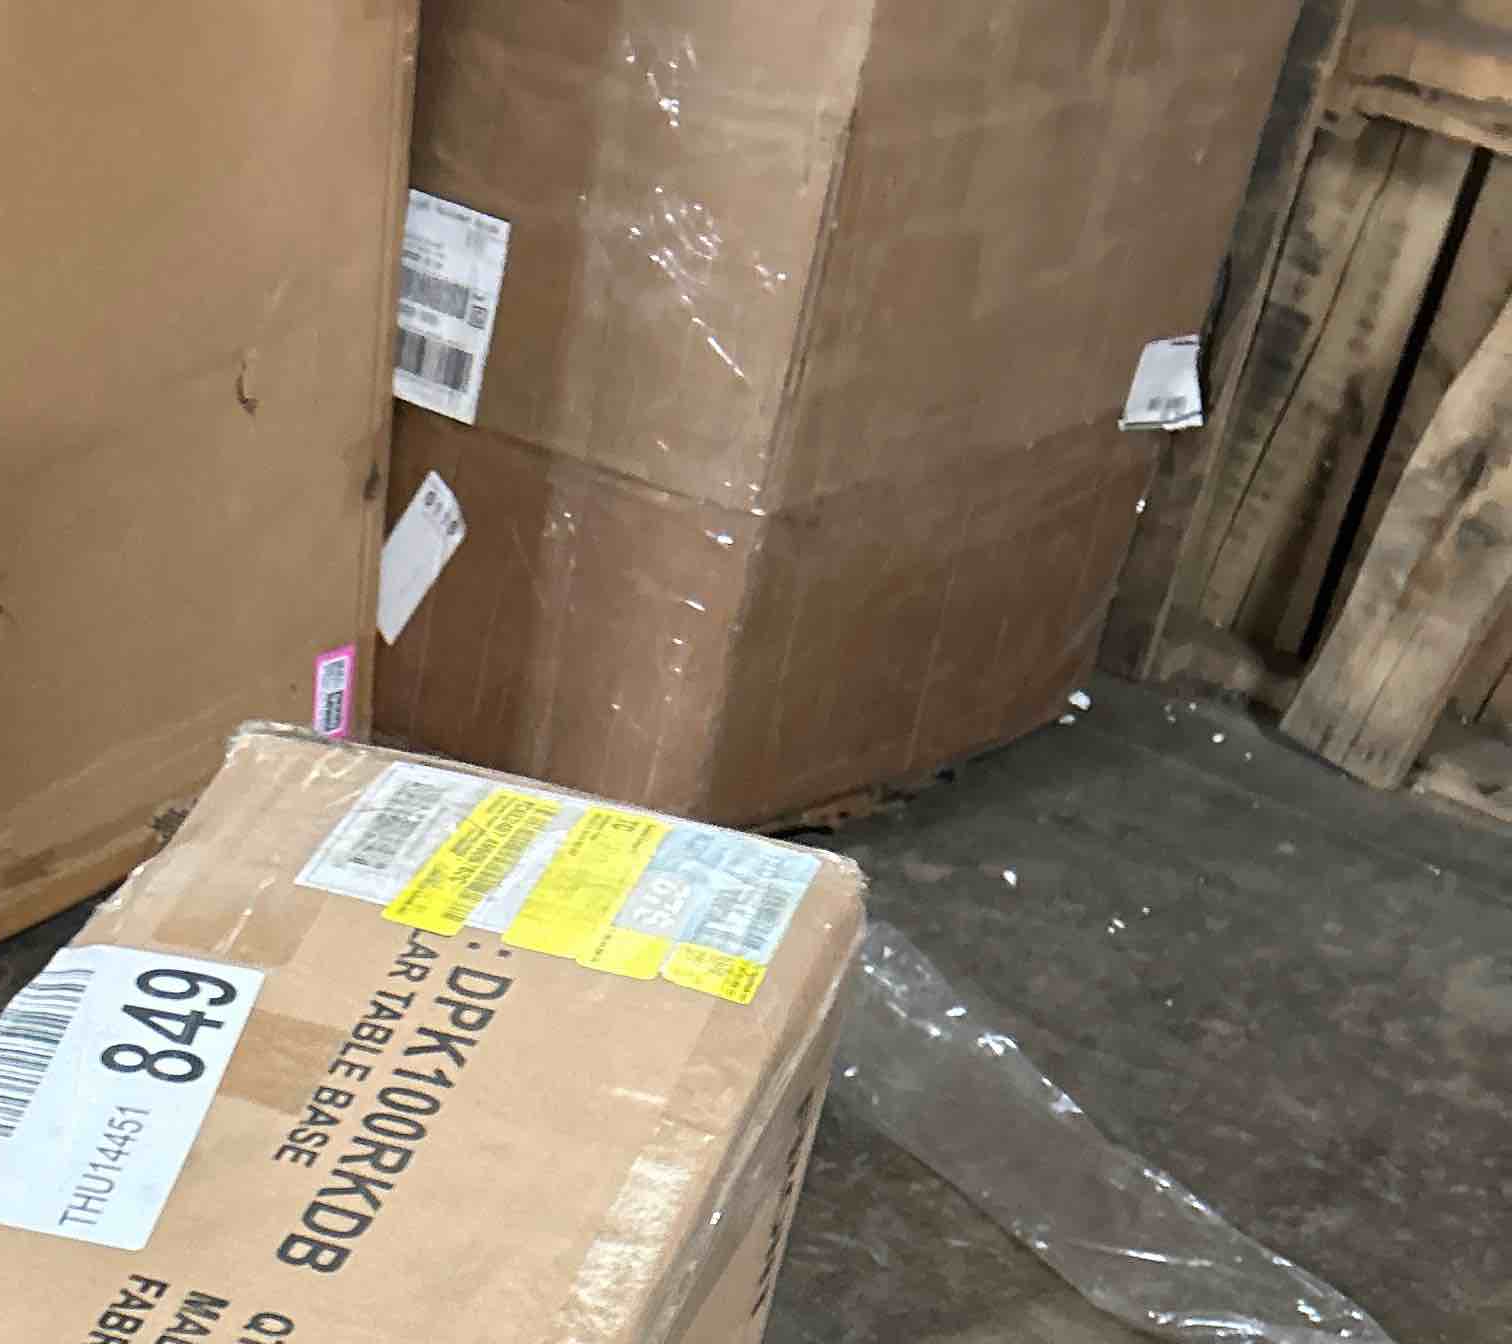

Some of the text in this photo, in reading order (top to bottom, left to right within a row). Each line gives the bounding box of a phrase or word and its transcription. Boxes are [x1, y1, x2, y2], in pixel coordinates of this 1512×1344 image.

[96, 969, 245, 1086] 849
[323, 984, 420, 1082] TABLE
[57, 1104, 150, 1226] THU14451
[270, 1084, 357, 1169] BASE
[271, 966, 514, 1276] DPK100RKDB
